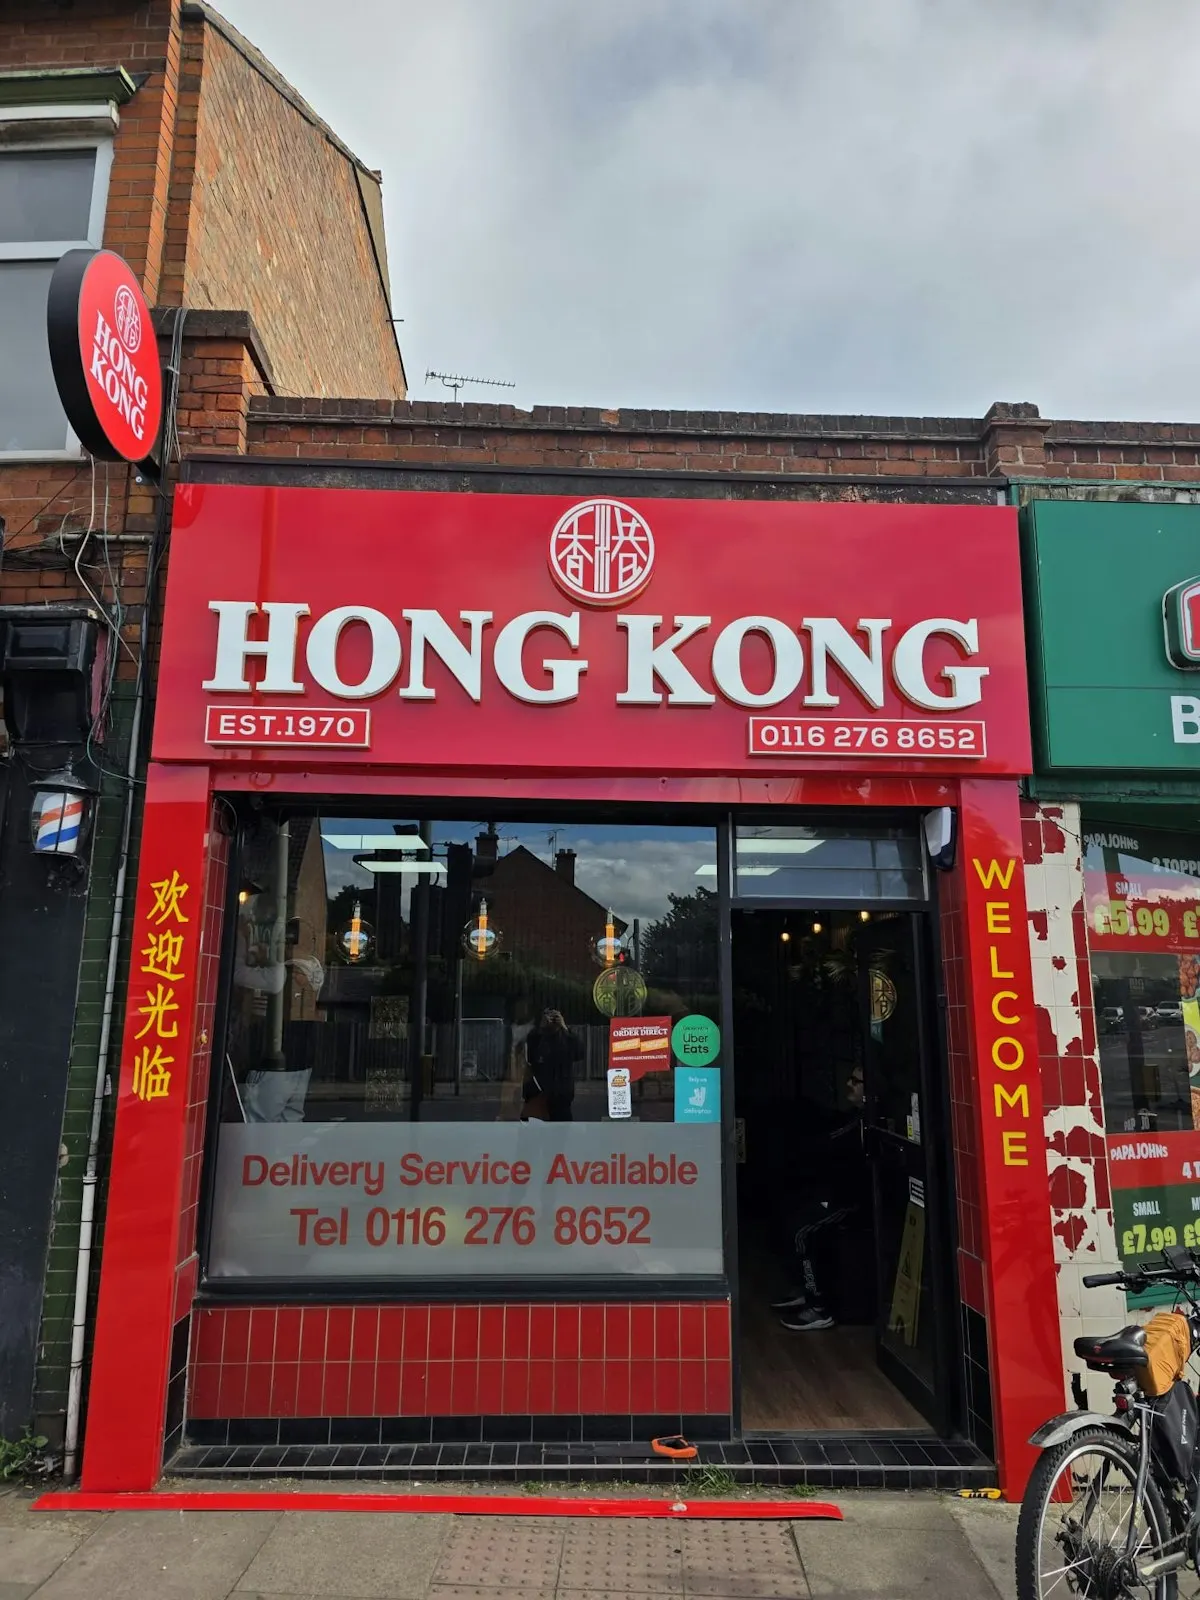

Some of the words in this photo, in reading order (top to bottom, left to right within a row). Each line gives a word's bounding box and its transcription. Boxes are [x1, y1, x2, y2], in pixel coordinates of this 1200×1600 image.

[94, 309, 148, 410] HONG
[90, 342, 144, 441] KONG
[202, 600, 588, 704] HONG
[616, 614, 989, 710] KONG
[219, 715, 356, 738] EST.1970
[760, 725, 825, 747] 0116
[834, 726, 889, 748] 276
[897, 727, 976, 749] 8652
[1115, 882, 1142, 895] SMALL
[1094, 900, 1170, 937] £5.99
[131, 870, 190, 1102] 欢迎光临
[972, 858, 1029, 1166] WELCOME
[613, 1029, 640, 1037] ORDER
[640, 1028, 668, 1036] DIRECT
[683, 1033, 708, 1043] Uber
[684, 1044, 709, 1054] Eats
[242, 1154, 385, 1196] Delivery
[400, 1153, 531, 1186] Service
[546, 1153, 698, 1185] Available
[1182, 1161, 1192, 1178] 4
[1133, 1201, 1160, 1216] SMALL
[290, 1207, 348, 1246] Tel
[366, 1206, 446, 1246] 0116
[463, 1206, 536, 1245] 276
[554, 1206, 651, 1245] 8652
[1122, 1224, 1177, 1255] £7.99
